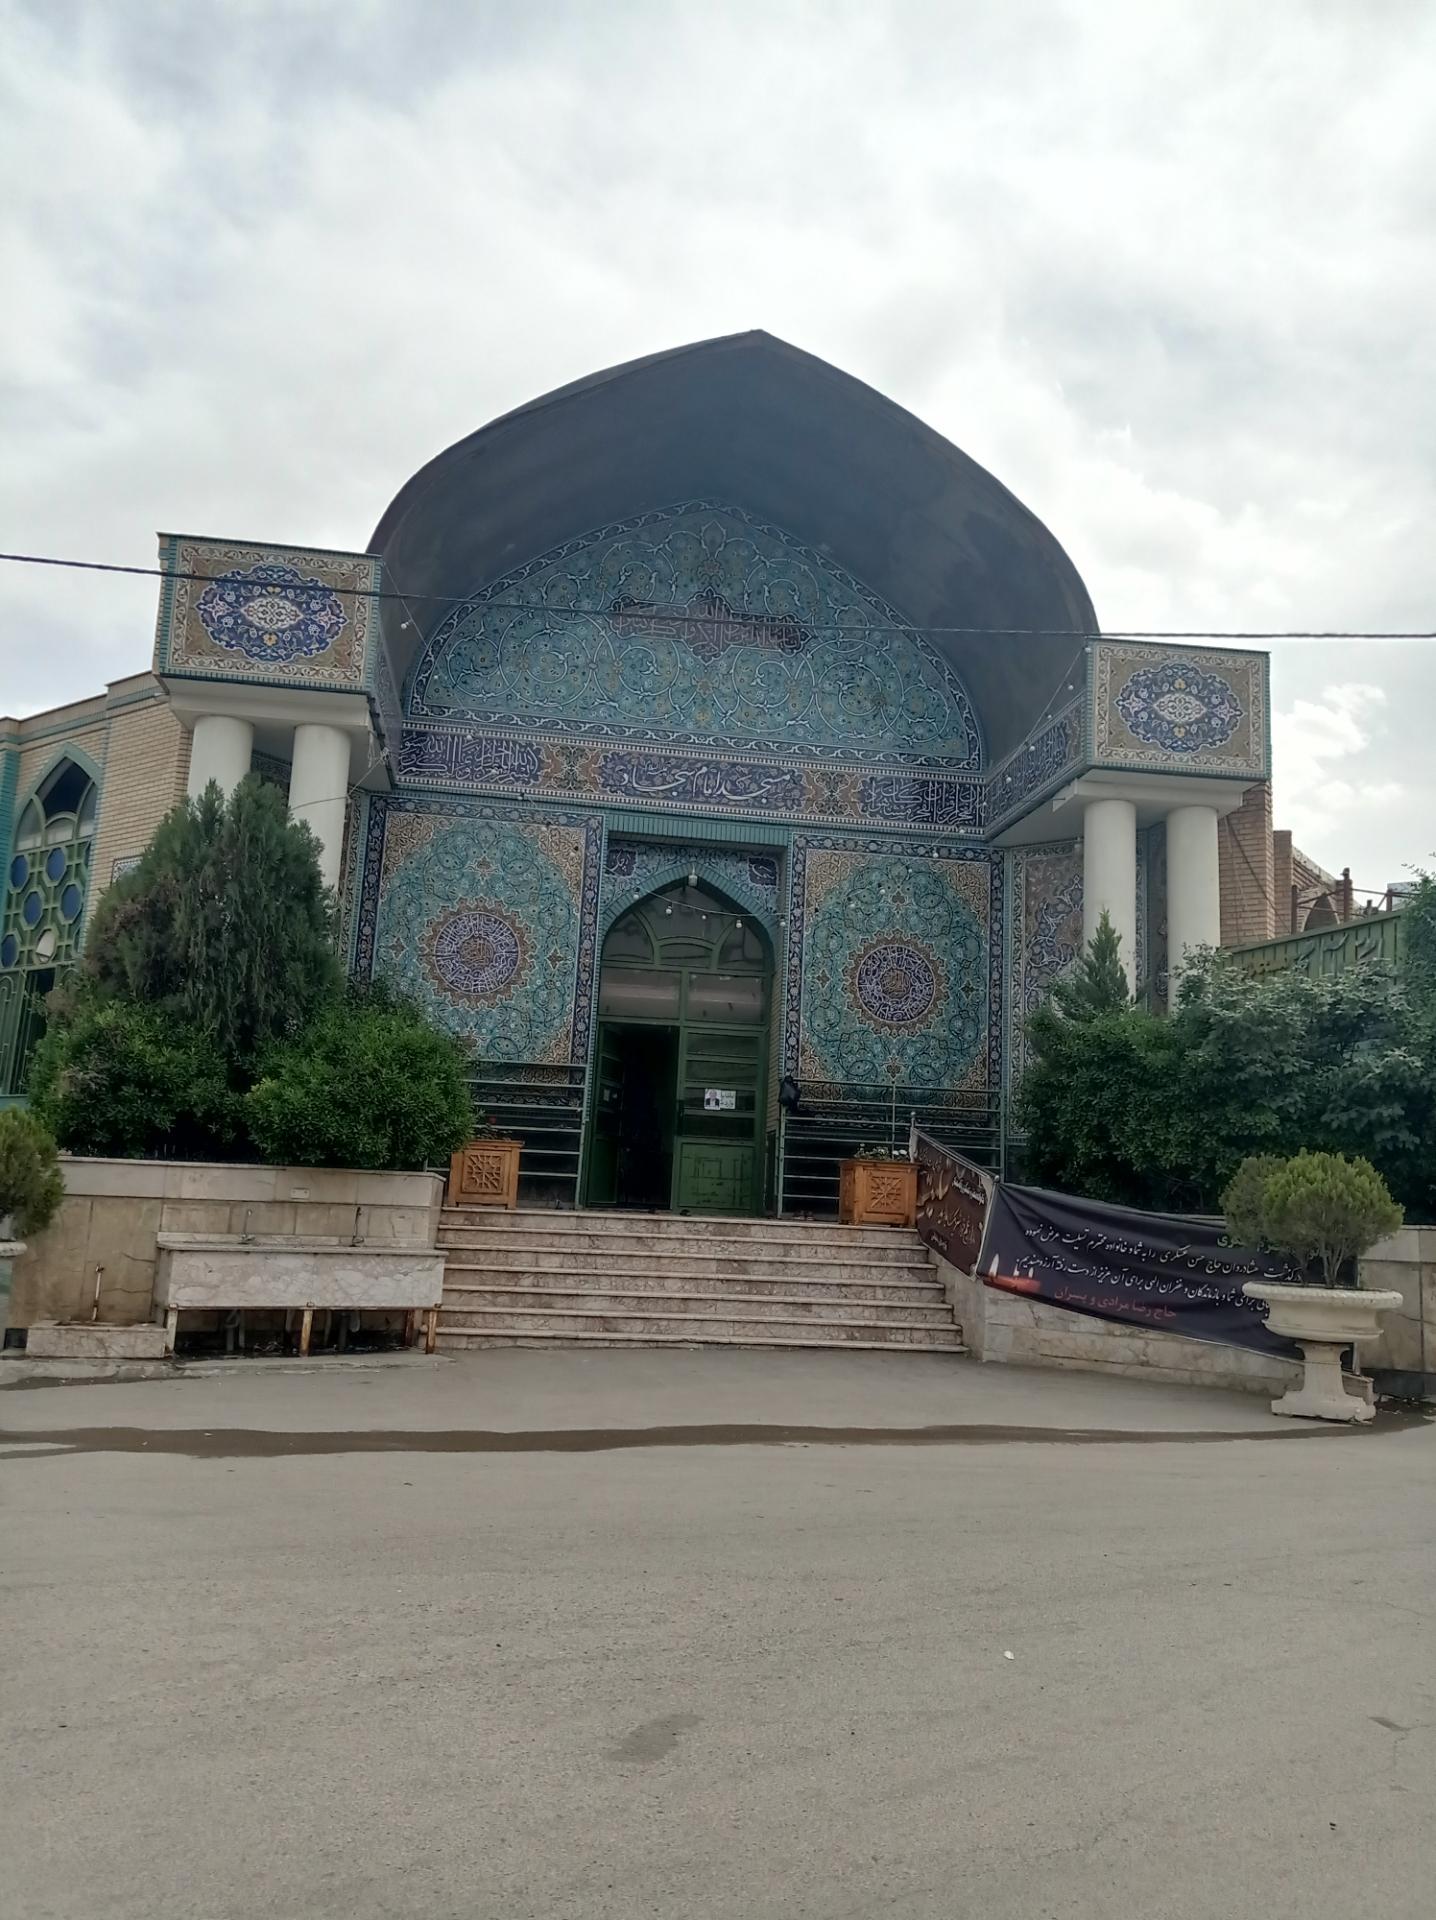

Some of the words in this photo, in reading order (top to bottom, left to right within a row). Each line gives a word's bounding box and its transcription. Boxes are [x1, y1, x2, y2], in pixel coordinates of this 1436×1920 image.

[1040, 1225, 1060, 1242] عرض
[1062, 1228, 1090, 1250] تسلیت
[1149, 1248, 1156, 1258] را
[1159, 1244, 1192, 1262] عسکری
[1187, 1255, 1205, 1267] حسن
[1067, 1263, 1090, 1276] دست
[1205, 1257, 1221, 1273] حاج
[1263, 1263, 1302, 1281] درگذشت
[1110, 1267, 1129, 1284] آن
[1124, 1274, 1143, 1291] برای
[1144, 1275, 1159, 1290] الهی
[1054, 1285, 1088, 1301] پسران
[1090, 1296, 1096, 1306] و
[1097, 1295, 1129, 1312] مرادی
[1131, 1300, 1152, 1318] رضا
[1153, 1304, 1177, 1320] حاج
